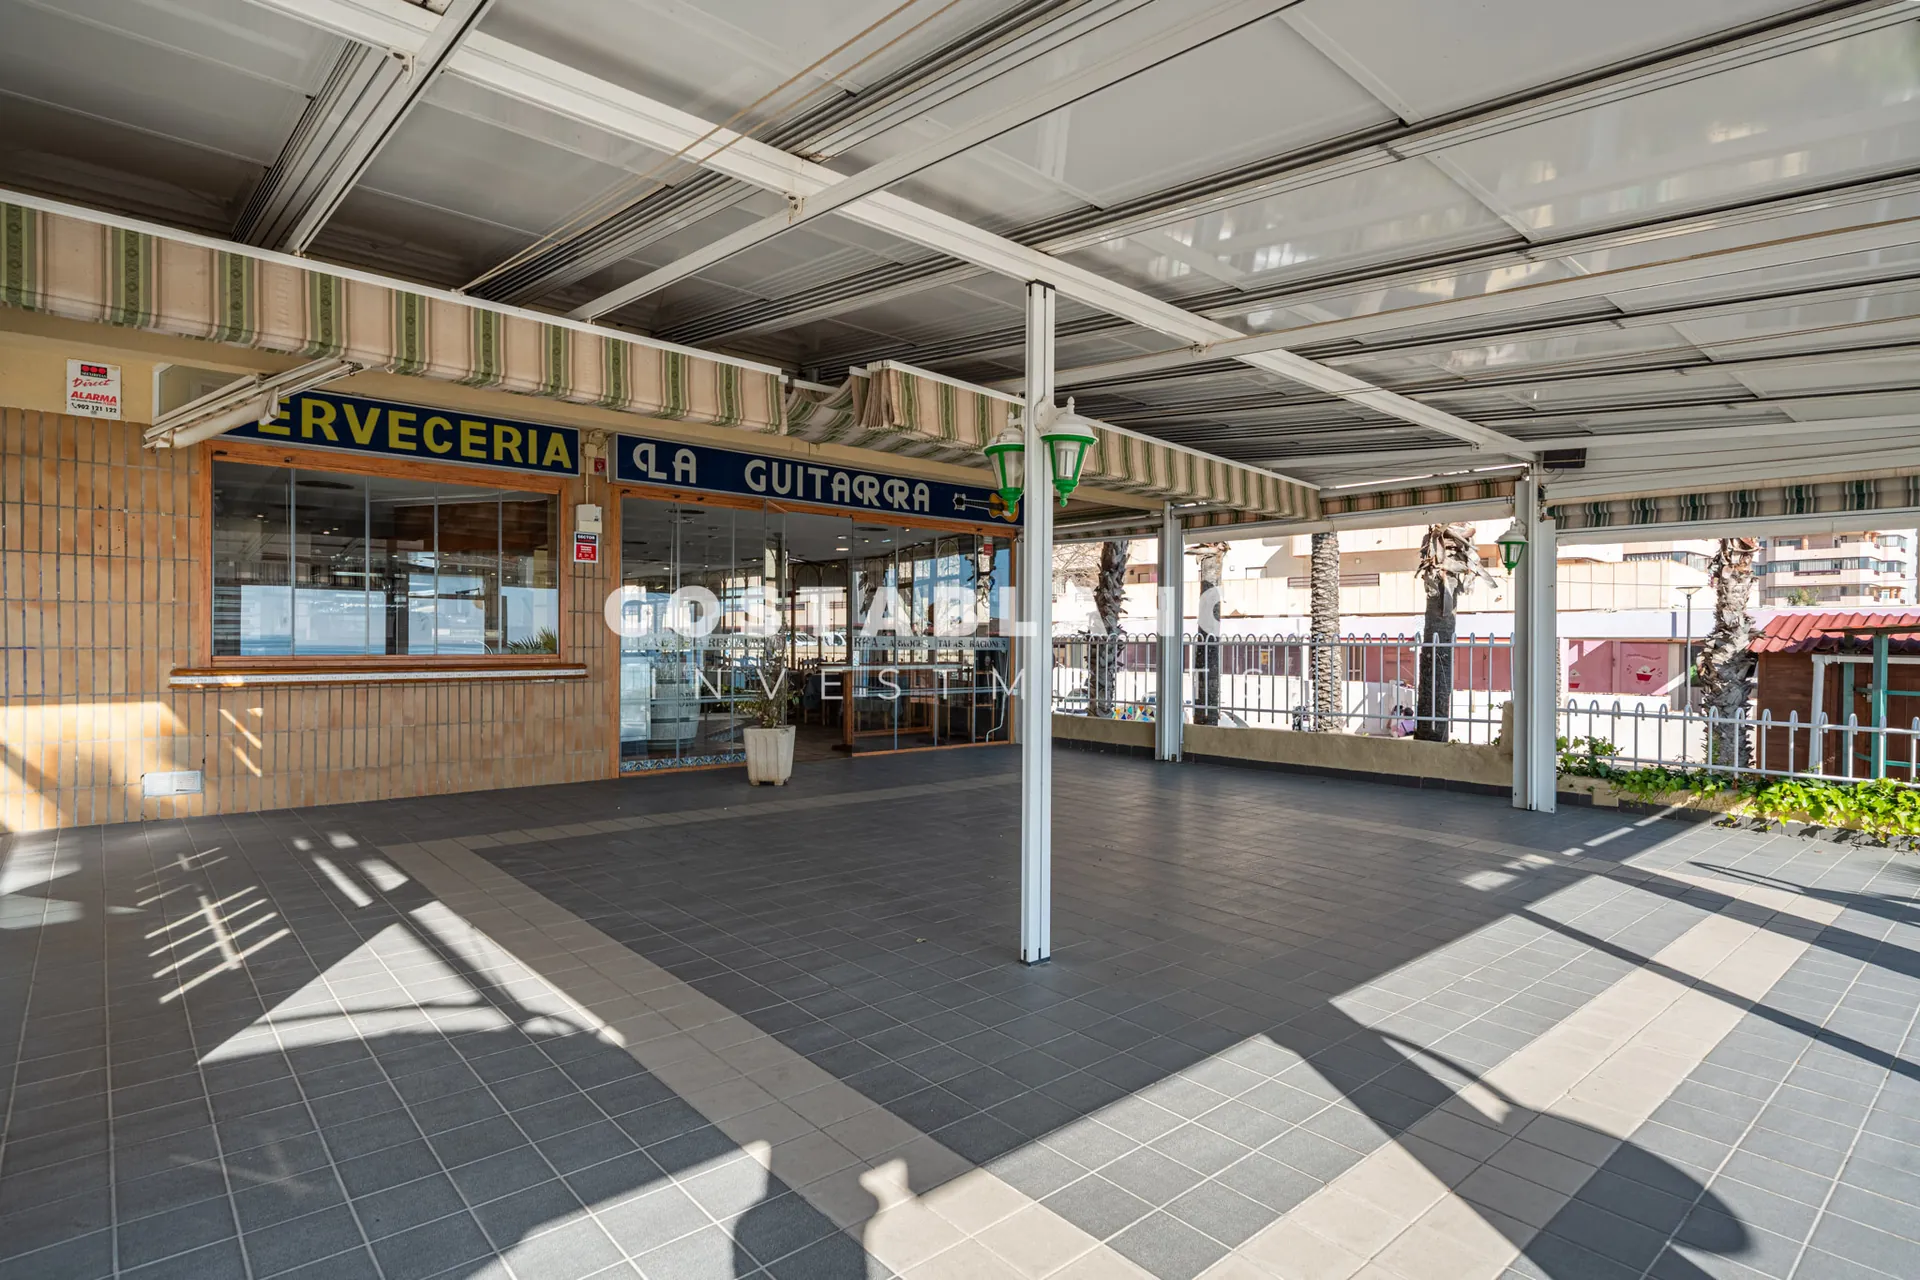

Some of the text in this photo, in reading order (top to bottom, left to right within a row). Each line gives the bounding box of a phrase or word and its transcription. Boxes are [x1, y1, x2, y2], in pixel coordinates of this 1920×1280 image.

[71, 391, 117, 404] ALARMA
[72, 377, 115, 388] Direct
[257, 397, 573, 469] ERVECERIA
[632, 443, 930, 512] LA GUITARRA
